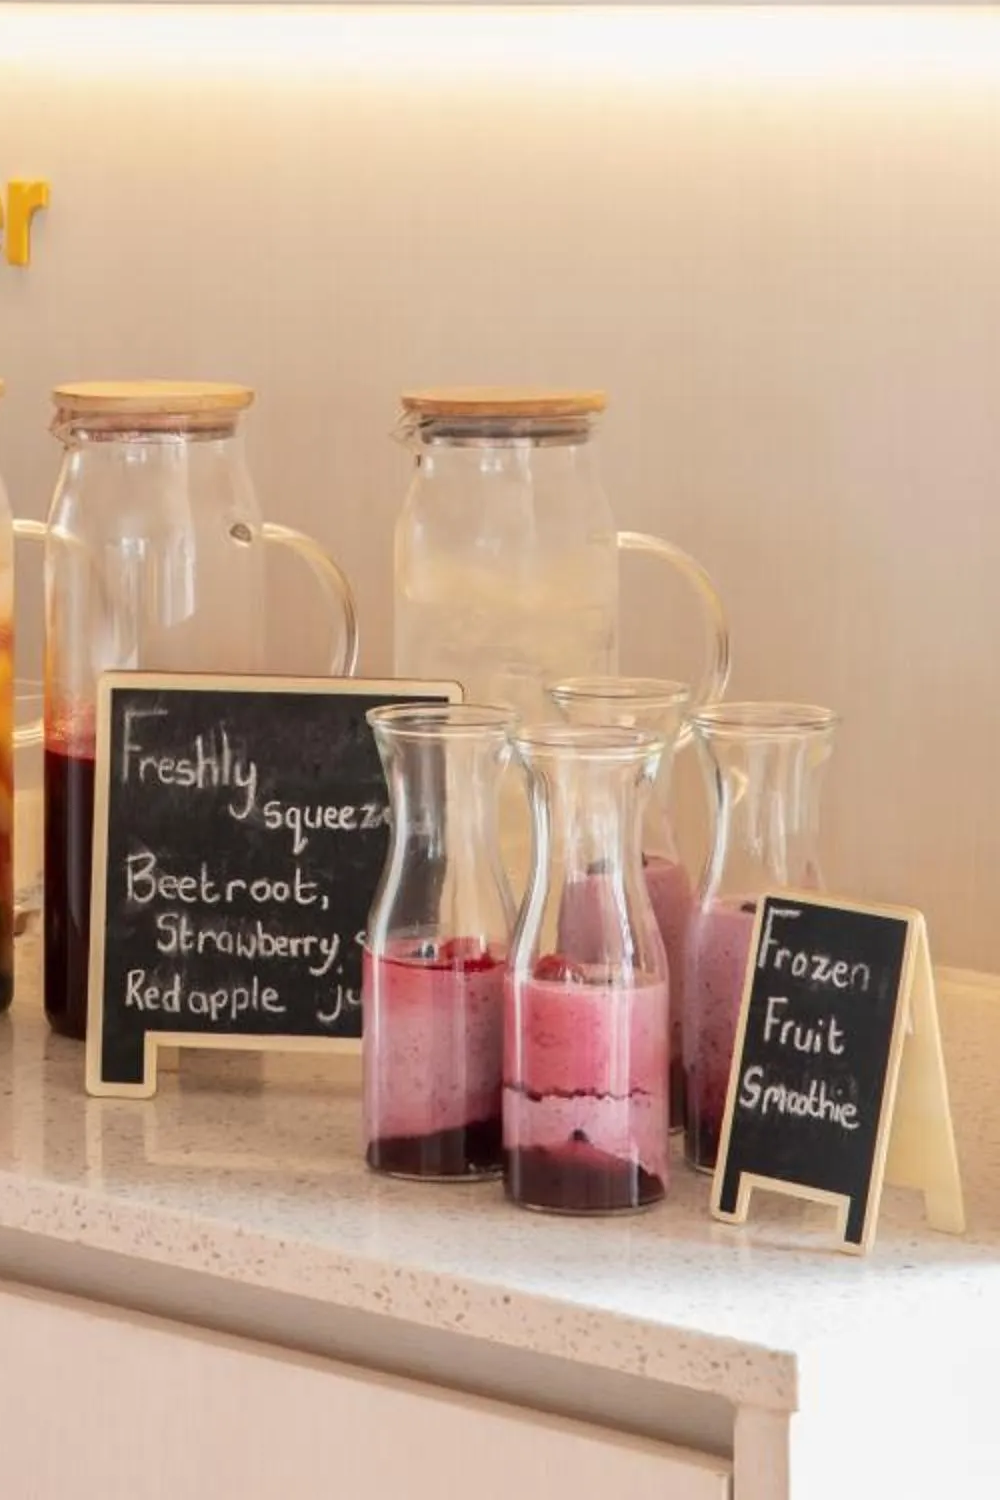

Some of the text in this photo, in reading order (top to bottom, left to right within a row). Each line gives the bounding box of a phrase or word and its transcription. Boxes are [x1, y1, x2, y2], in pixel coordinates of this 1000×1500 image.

[121, 707, 258, 820] Freshly
[155, 913, 340, 976] Strawberry
[757, 907, 870, 991] Frozen
[763, 997, 845, 1056] Fruit
[739, 1065, 861, 1130] Smoothie
